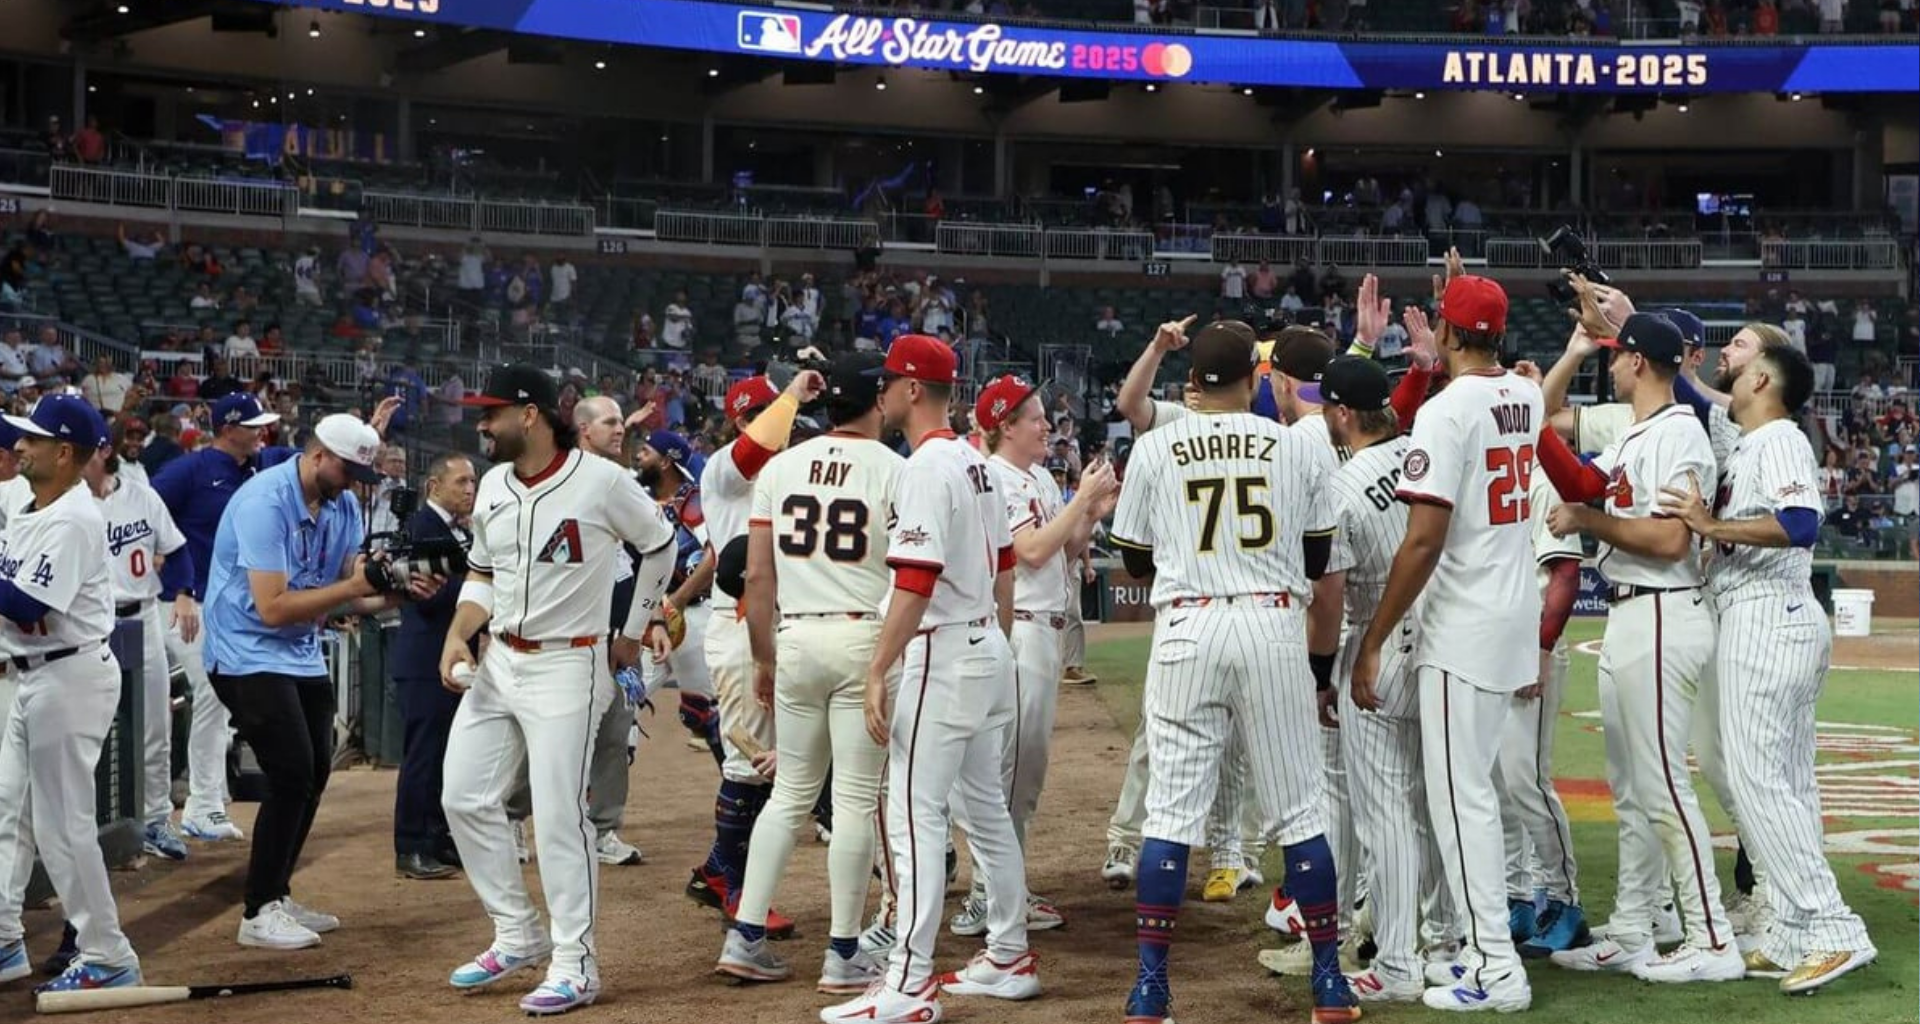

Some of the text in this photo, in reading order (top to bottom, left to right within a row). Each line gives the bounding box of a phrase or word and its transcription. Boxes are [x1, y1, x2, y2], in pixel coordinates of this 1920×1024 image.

[805, 14, 882, 59] All
[965, 24, 1066, 72] Game
[1073, 44, 1138, 71] 2025
[1147, 264, 1167, 275] 127
[1490, 403, 1530, 436] WOOD
[1171, 434, 1277, 466] SUAREZ
[809, 460, 852, 487] RAY
[778, 493, 869, 563] 38
[1184, 475, 1275, 553] 75
[30, 553, 53, 588] LA
[130, 549, 145, 577] 0
